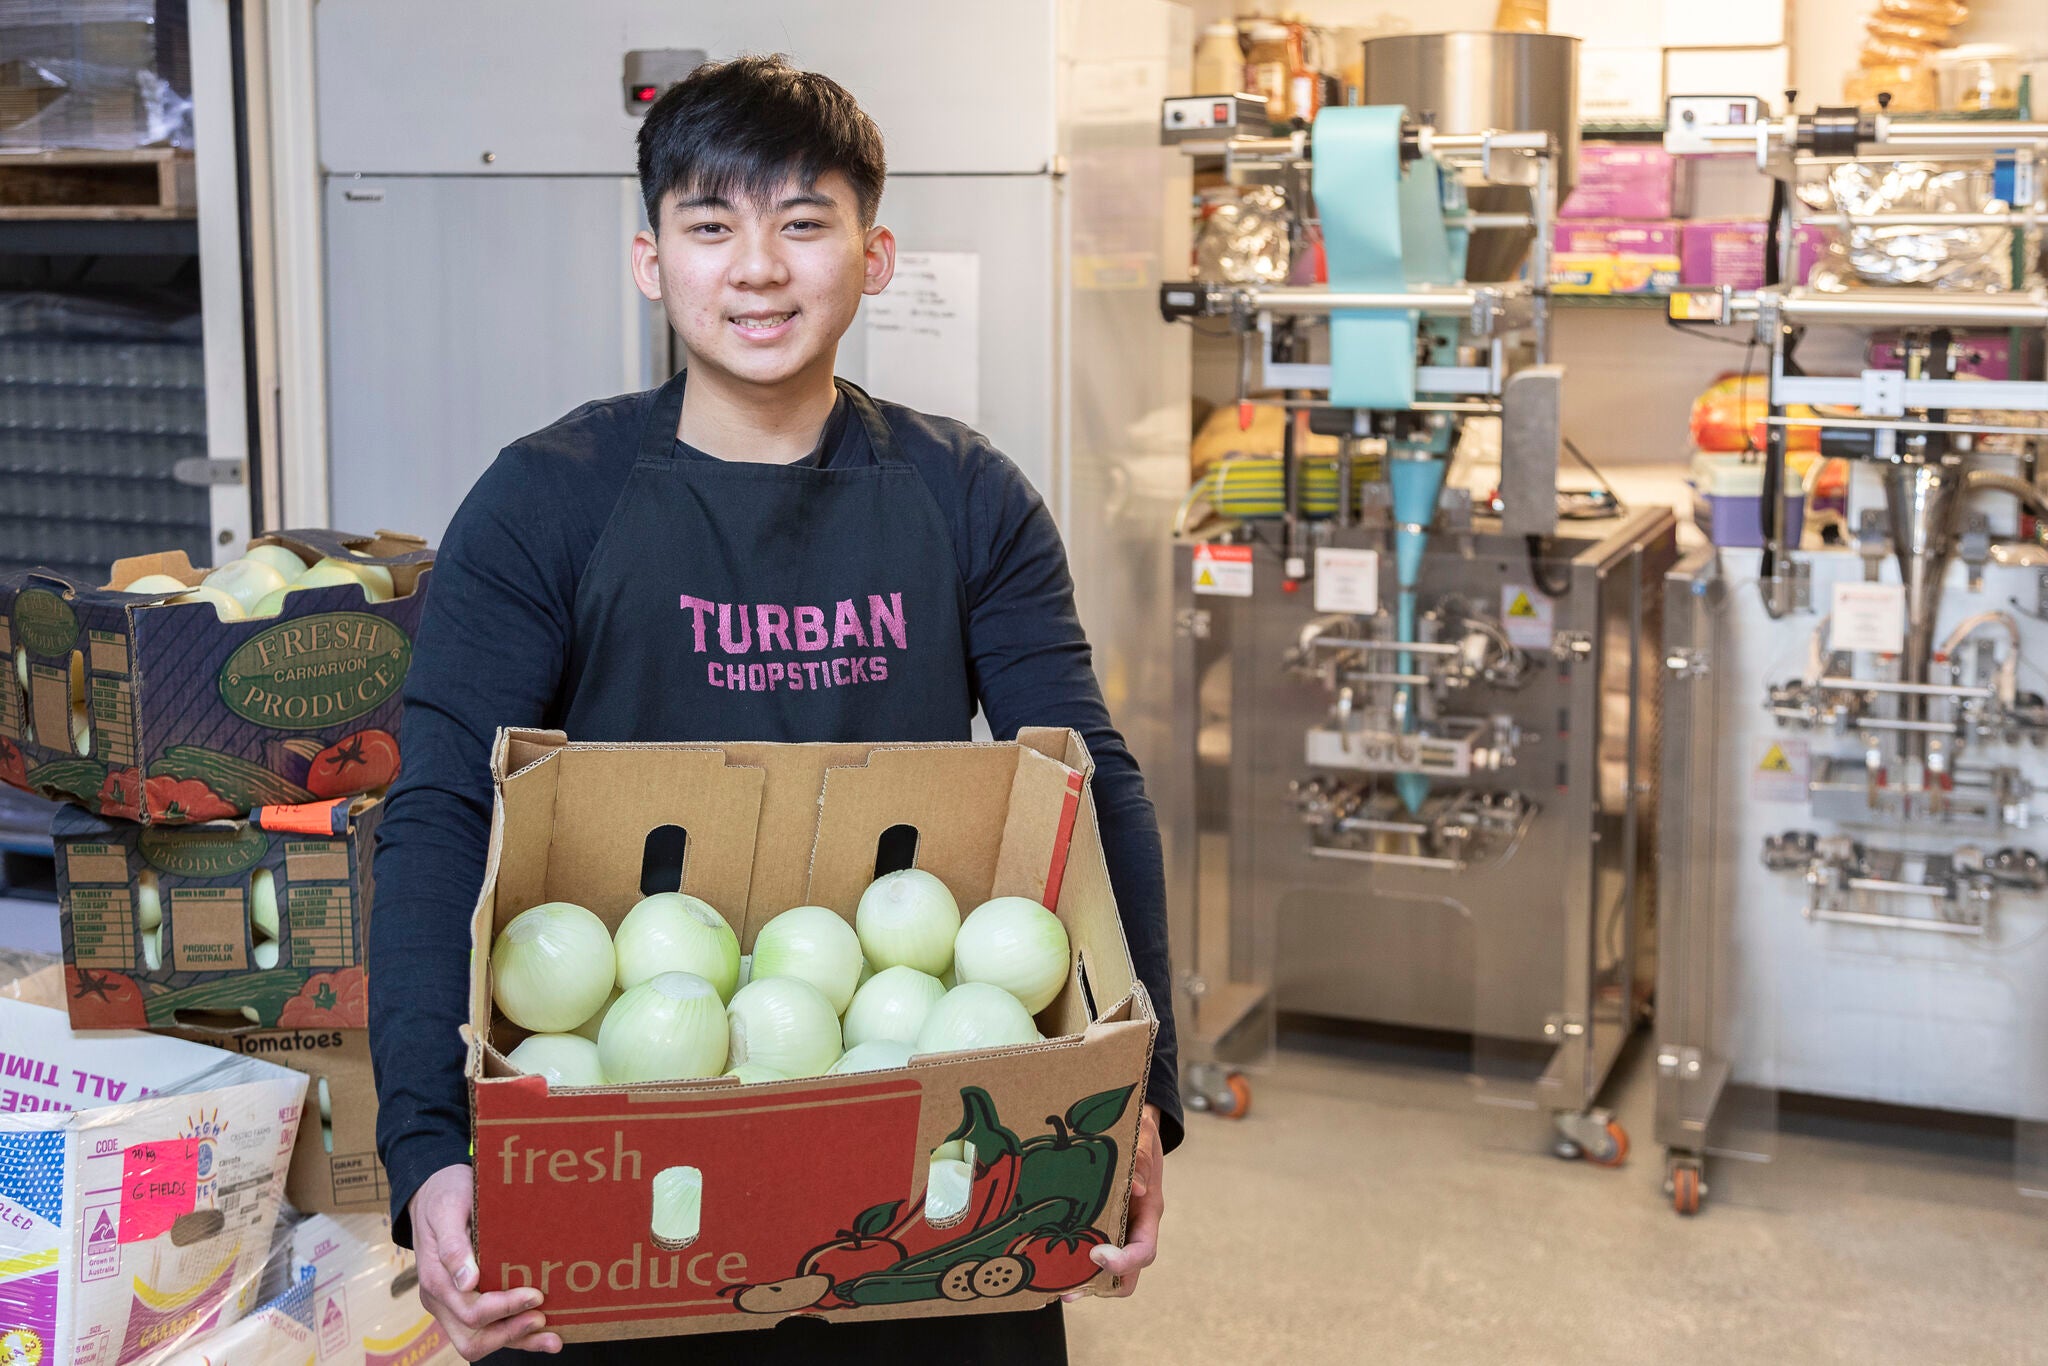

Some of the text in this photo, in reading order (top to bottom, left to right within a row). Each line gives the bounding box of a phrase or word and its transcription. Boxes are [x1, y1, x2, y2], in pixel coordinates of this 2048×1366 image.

[680, 592, 907, 654] TURBAN
[254, 620, 381, 670] FRESH
[274, 657, 368, 684] CARNARVON
[708, 656, 889, 691] CHOPSTICKS
[241, 664, 396, 719] PRODUCE
[153, 847, 260, 871] PRODUCE
[183, 944, 235, 953] PRODUCT OF
[186, 954, 233, 962] AUSTRALIA
[232, 1031, 343, 1053] Tomatoes
[72, 1069, 128, 1102] ALL
[96, 1138, 119, 1153] CODE
[334, 1159, 362, 1170] GRAPE
[497, 1131, 643, 1185] fresh
[150, 1181, 186, 1199] FIELDS
[335, 1175, 368, 1186] CHERRY
[88, 1266, 115, 1276] Australia
[89, 1255, 115, 1267] Grown in
[500, 1242, 748, 1295] produce
